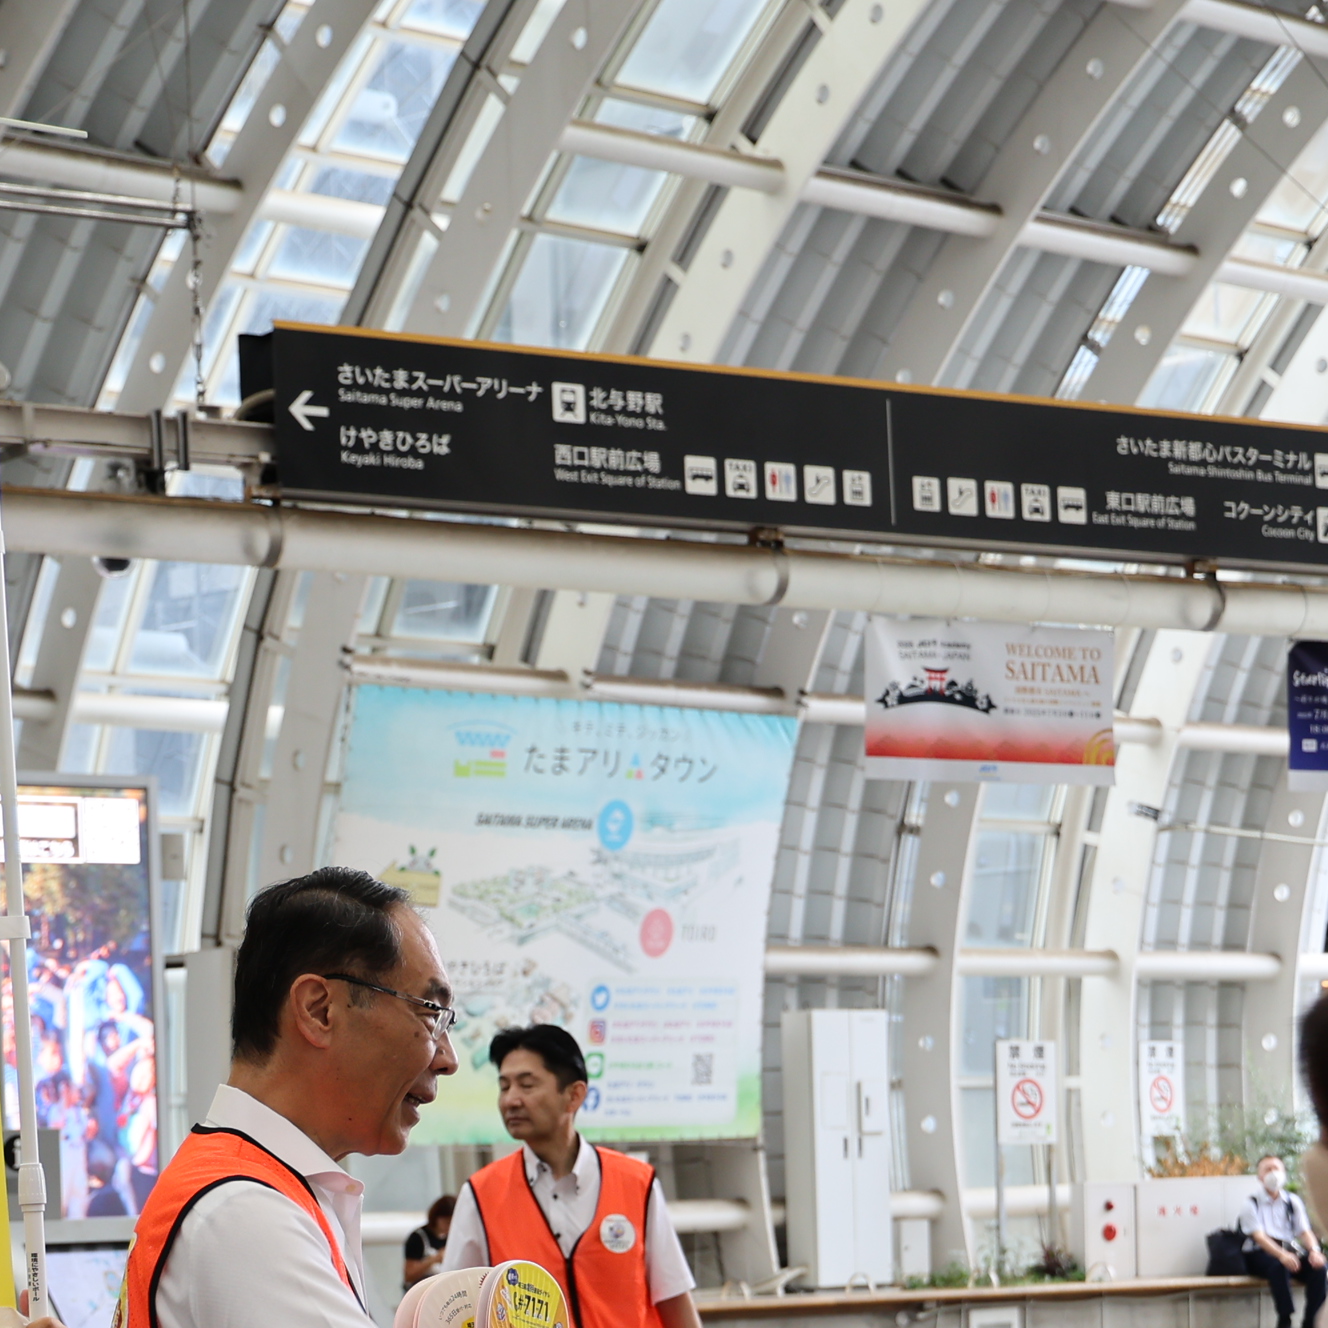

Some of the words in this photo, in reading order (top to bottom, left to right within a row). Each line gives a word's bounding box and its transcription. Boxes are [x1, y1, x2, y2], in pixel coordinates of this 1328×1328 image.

[337, 363, 544, 403] さいたまスーパーアリーナ
[337, 387, 388, 406] Saitama
[389, 392, 424, 410] Super
[426, 396, 463, 413] Arena
[589, 386, 664, 415] 北与野駅
[589, 411, 645, 430] Kita-Yono
[646, 416, 667, 431] Sta.
[339, 425, 452, 456] けやきひろば
[1116, 434, 1313, 471] さいたま新都心バスターミナル
[340, 450, 381, 468] Keyaki
[383, 453, 425, 470] Hiroba
[553, 443, 661, 474] 西口駅前広場
[728, 461, 753, 473] TAXI
[553, 467, 579, 482] West
[580, 468, 599, 484] Exit
[599, 471, 634, 489] Square
[635, 474, 646, 488] of
[646, 475, 682, 491] Station
[1256, 468, 1273, 484] Bus
[1274, 472, 1313, 487] Terminal
[1024, 487, 1048, 497] TAXI
[1105, 490, 1197, 518] 東口駅前広場
[1092, 511, 1110, 525] East
[1111, 512, 1127, 527] Exit
[1127, 514, 1156, 530] Square
[1157, 516, 1166, 528] of
[1166, 516, 1197, 532] Station
[1223, 500, 1315, 526] コクーンシティ
[1261, 523, 1296, 539] Cocoon
[1297, 525, 1315, 542] City
[1005, 642, 1075, 660] WELCOME
[1079, 647, 1102, 662] TO
[1004, 659, 1101, 686] SAITAMA
